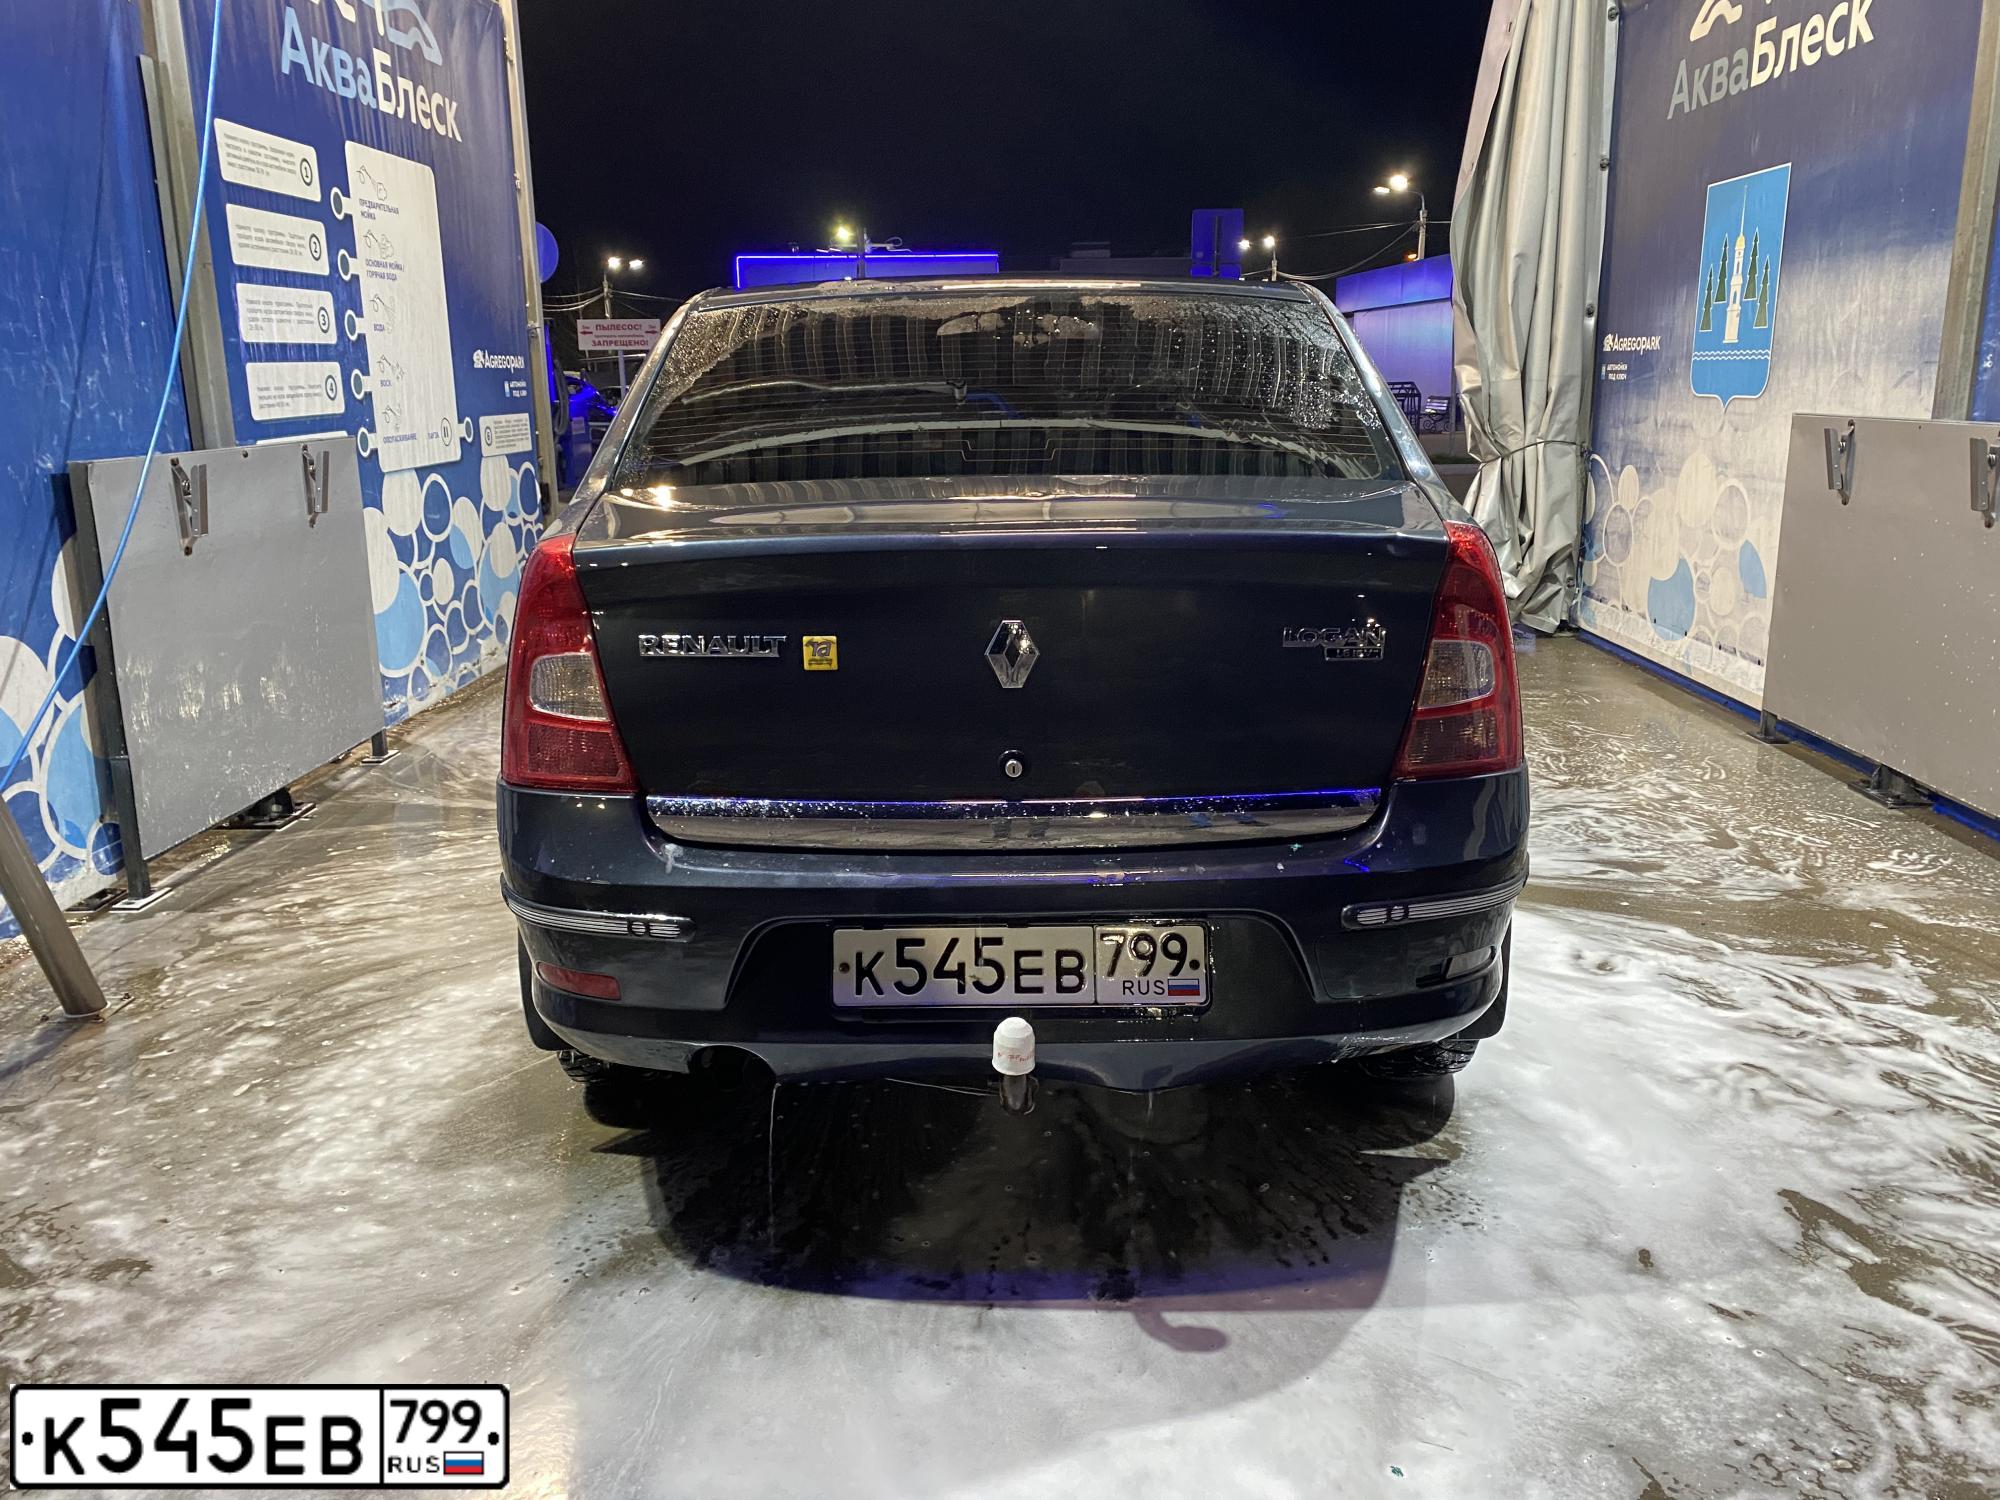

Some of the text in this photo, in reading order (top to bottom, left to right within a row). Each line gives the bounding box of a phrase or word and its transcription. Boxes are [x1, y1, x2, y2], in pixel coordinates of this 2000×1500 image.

[1666, 0, 1874, 120] АкваБлеск
[281, 6, 462, 143] АкваБлеск
[359, 198, 399, 215] ПРЕДВАРИТЕЛЬНАЯ
[360, 208, 376, 220] МОЙКА
[365, 258, 388, 270] ОСНОВНАЯ
[366, 269, 398, 281] ГОРЯЧАЯ ВОДА
[373, 323, 385, 332] ВОДА
[595, 323, 642, 331] ПЫЛЕСОС!
[592, 339, 649, 347] ЗАПРЕЩЕНО!
[380, 379, 392, 388] ВОСК
[1282, 627, 1386, 648] LOGAN
[638, 634, 788, 658] RENAULT
[1100, 931, 1189, 978] 799
[1121, 979, 1166, 997] RUS
